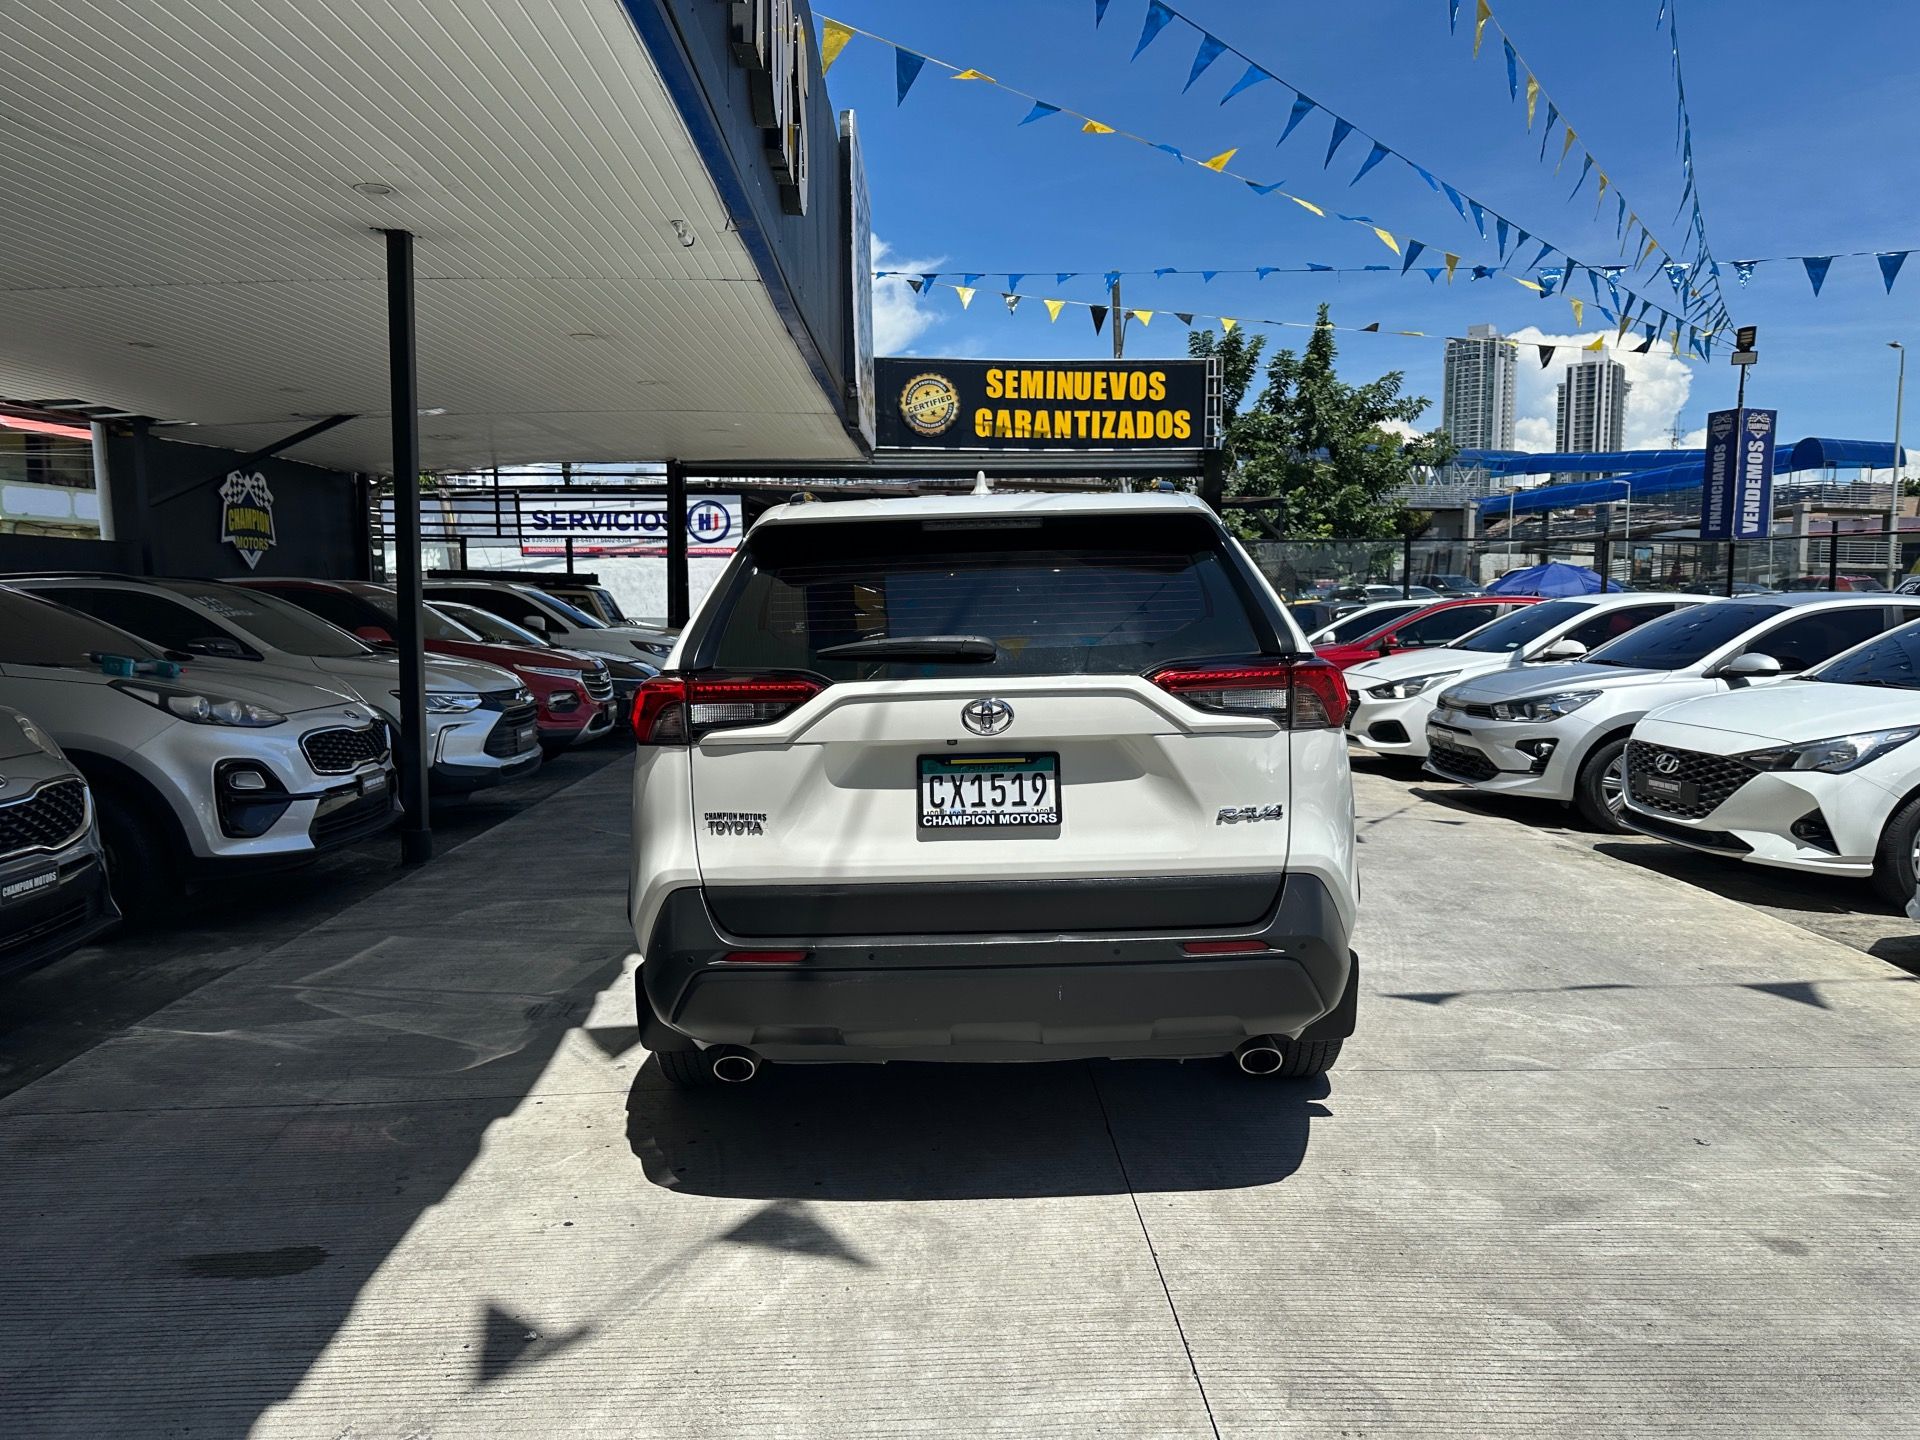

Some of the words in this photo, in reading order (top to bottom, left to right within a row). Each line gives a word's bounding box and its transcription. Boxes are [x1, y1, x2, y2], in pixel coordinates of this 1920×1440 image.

[986, 369, 1166, 401] SEMINUEVOS
[908, 394, 952, 414] CERTIFIED
[975, 407, 1191, 439] GARANTIZADOS
[1708, 443, 1726, 531] FINANCIAMOS
[1742, 440, 1765, 534] VENDEMOS
[228, 507, 270, 535] CHAMPION
[236, 536, 269, 551] MOTORS
[929, 772, 1047, 808] CX1519
[704, 812, 738, 821] CHAMPION
[738, 813, 767, 822] MOTORS
[708, 821, 764, 835] TOYOTA
[923, 815, 995, 826] CHAMPION
[999, 813, 1057, 825] MOTORS
[1216, 805, 1283, 825] RAV4
[2, 878, 34, 897] CHAMPION
[33, 871, 57, 887] MOTORS
